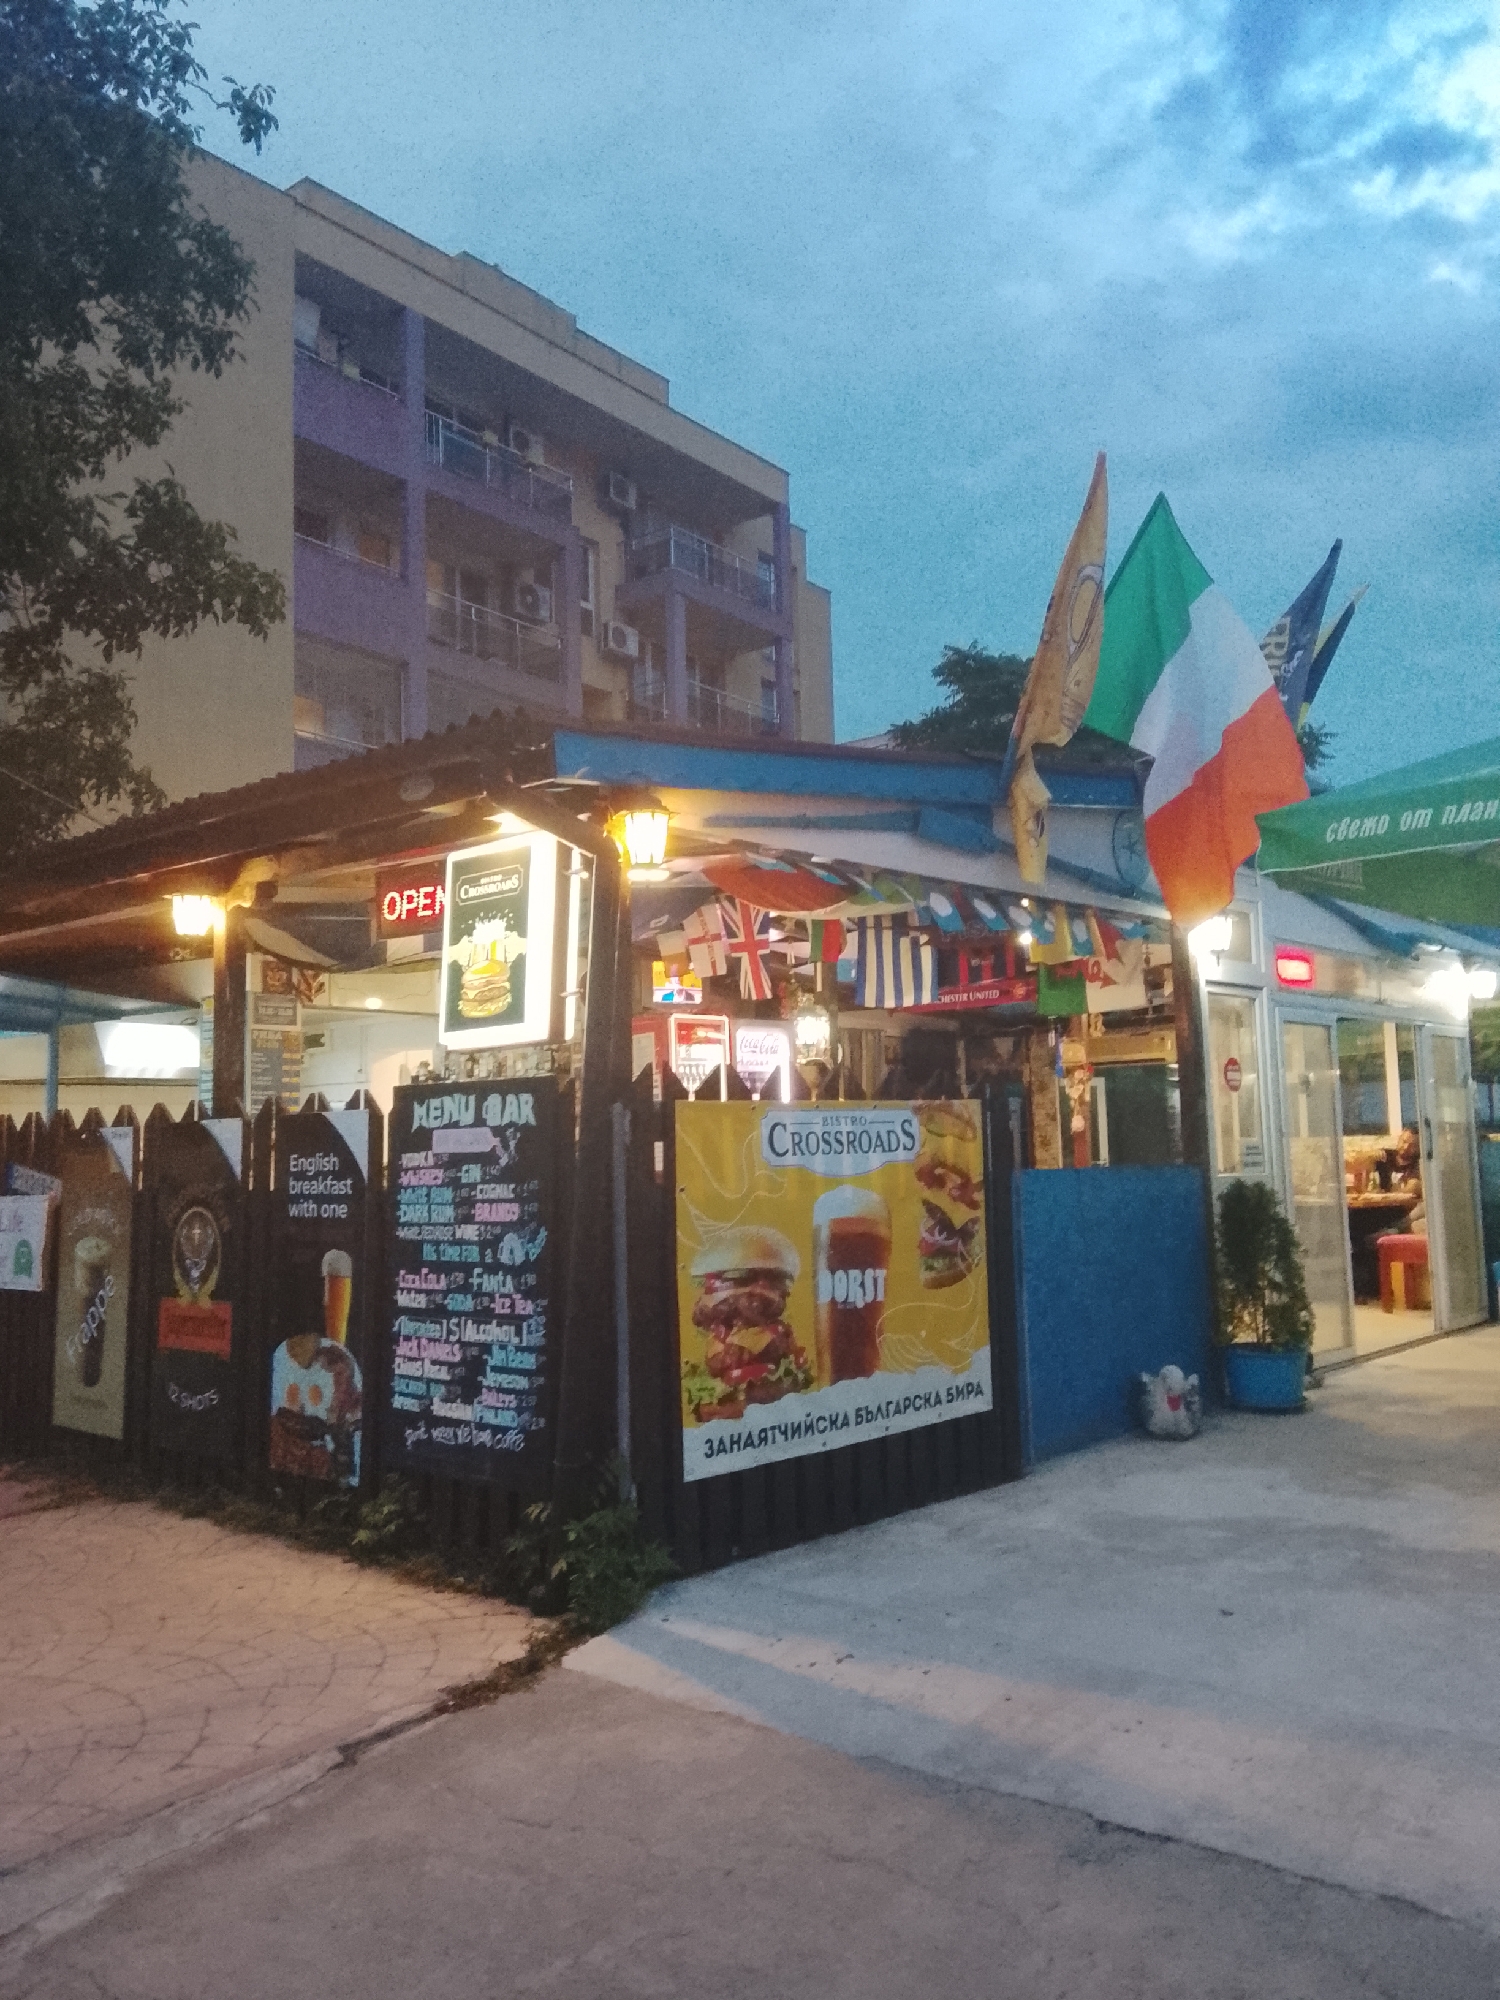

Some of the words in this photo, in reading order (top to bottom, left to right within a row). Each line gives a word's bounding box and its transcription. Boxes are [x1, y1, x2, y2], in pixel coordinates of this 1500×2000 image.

[1326, 814, 1391, 843] свежо
[1399, 808, 1435, 832] от
[1441, 798, 1500, 826] план
[460, 874, 519, 900] CROSSROADS
[969, 989, 1000, 1002] UNITED
[411, 1093, 476, 1132] MENU
[822, 1116, 868, 1127] BISTRO
[768, 1119, 917, 1158] CROSSROADS
[289, 1152, 339, 1175] English
[289, 1175, 354, 1195] breakfast
[289, 1199, 318, 1219] with
[321, 1204, 348, 1219] one
[703, 1410, 851, 1459] ЗАНАЯТЧИЙСКА
[854, 1391, 943, 1428] БЪЛГАРСКА
[946, 1381, 985, 1406] БИРА
